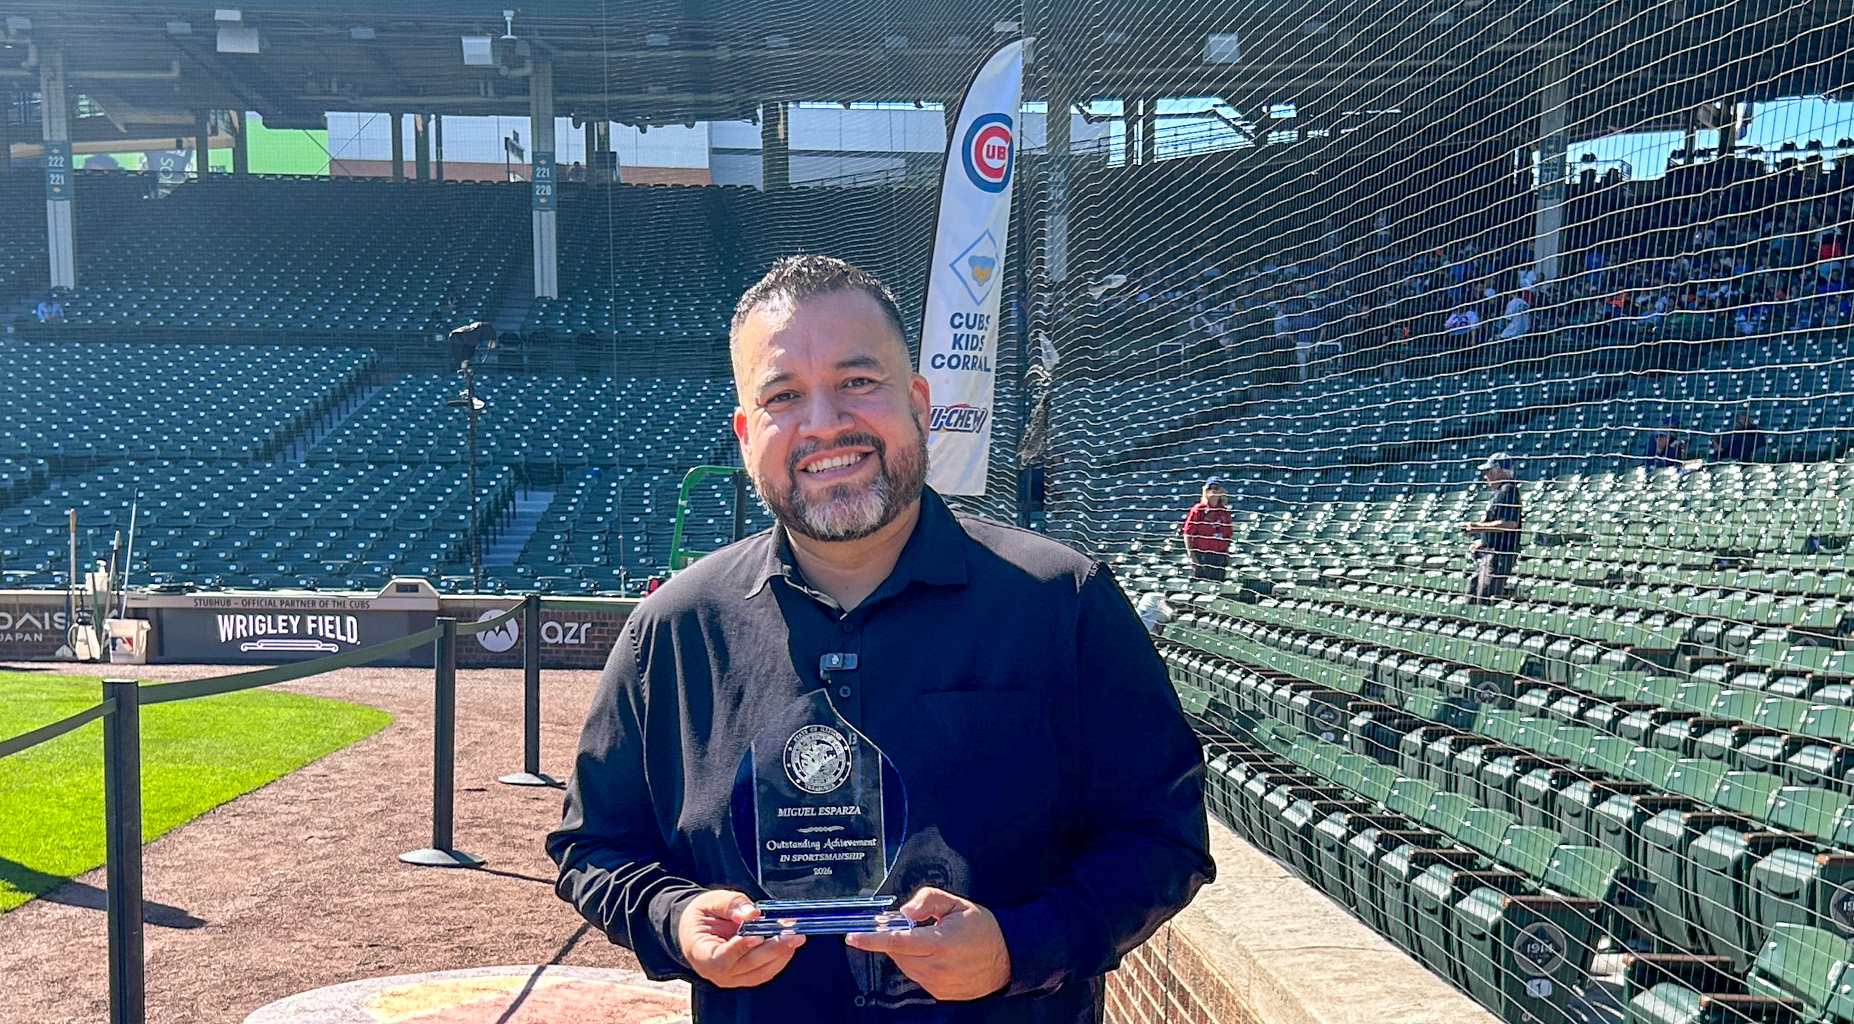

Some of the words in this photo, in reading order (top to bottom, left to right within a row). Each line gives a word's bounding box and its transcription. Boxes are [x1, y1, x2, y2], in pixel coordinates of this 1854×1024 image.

[48, 155, 65, 167] 222
[535, 167, 550, 178] 221
[49, 174, 65, 185] 221
[535, 185, 552, 196] 220
[949, 312, 991, 331] CUBS
[951, 333, 986, 352] KIDS
[930, 353, 991, 372] CORRAL
[194, 598, 231, 607] STUBHUB
[241, 599, 278, 607] OFFICIAL
[280, 599, 316, 608] PARTNER
[318, 600, 330, 608] OF
[332, 600, 347, 608] THE
[349, 600, 371, 609] CUBS
[0, 611, 73, 630] DAIS
[217, 613, 301, 643] WRIGLEY
[307, 614, 360, 645] FIELD
[540, 621, 592, 645] azr
[777, 807, 817, 817] MIGUEL
[818, 805, 862, 816] ESPARZA
[766, 838, 821, 851] Outstanding
[822, 838, 877, 849] Achievement
[780, 853, 790, 862] IN
[791, 852, 866, 862] SPORTSMANSHIP
[1527, 942, 1554, 953] 1914
